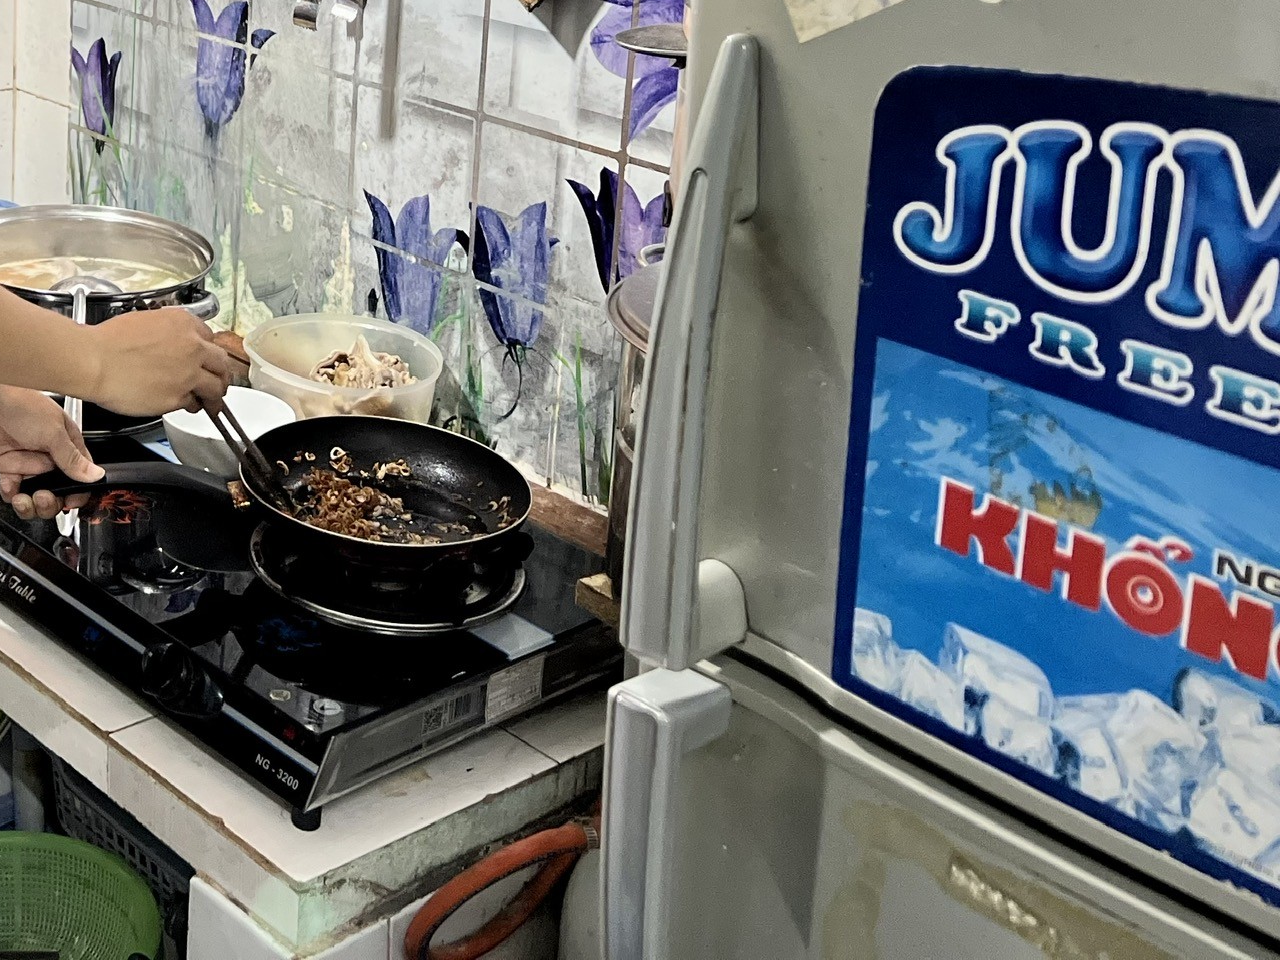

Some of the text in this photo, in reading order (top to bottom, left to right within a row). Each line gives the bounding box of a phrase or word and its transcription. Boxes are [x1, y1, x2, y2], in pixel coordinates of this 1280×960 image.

[893, 120, 1280, 358] JUM
[955, 289, 1280, 435] FREE
[8, 575, 37, 603] Table
[1212, 547, 1280, 603] NG
[255, 753, 271, 770] NG
[276, 768, 300, 790] 3200
